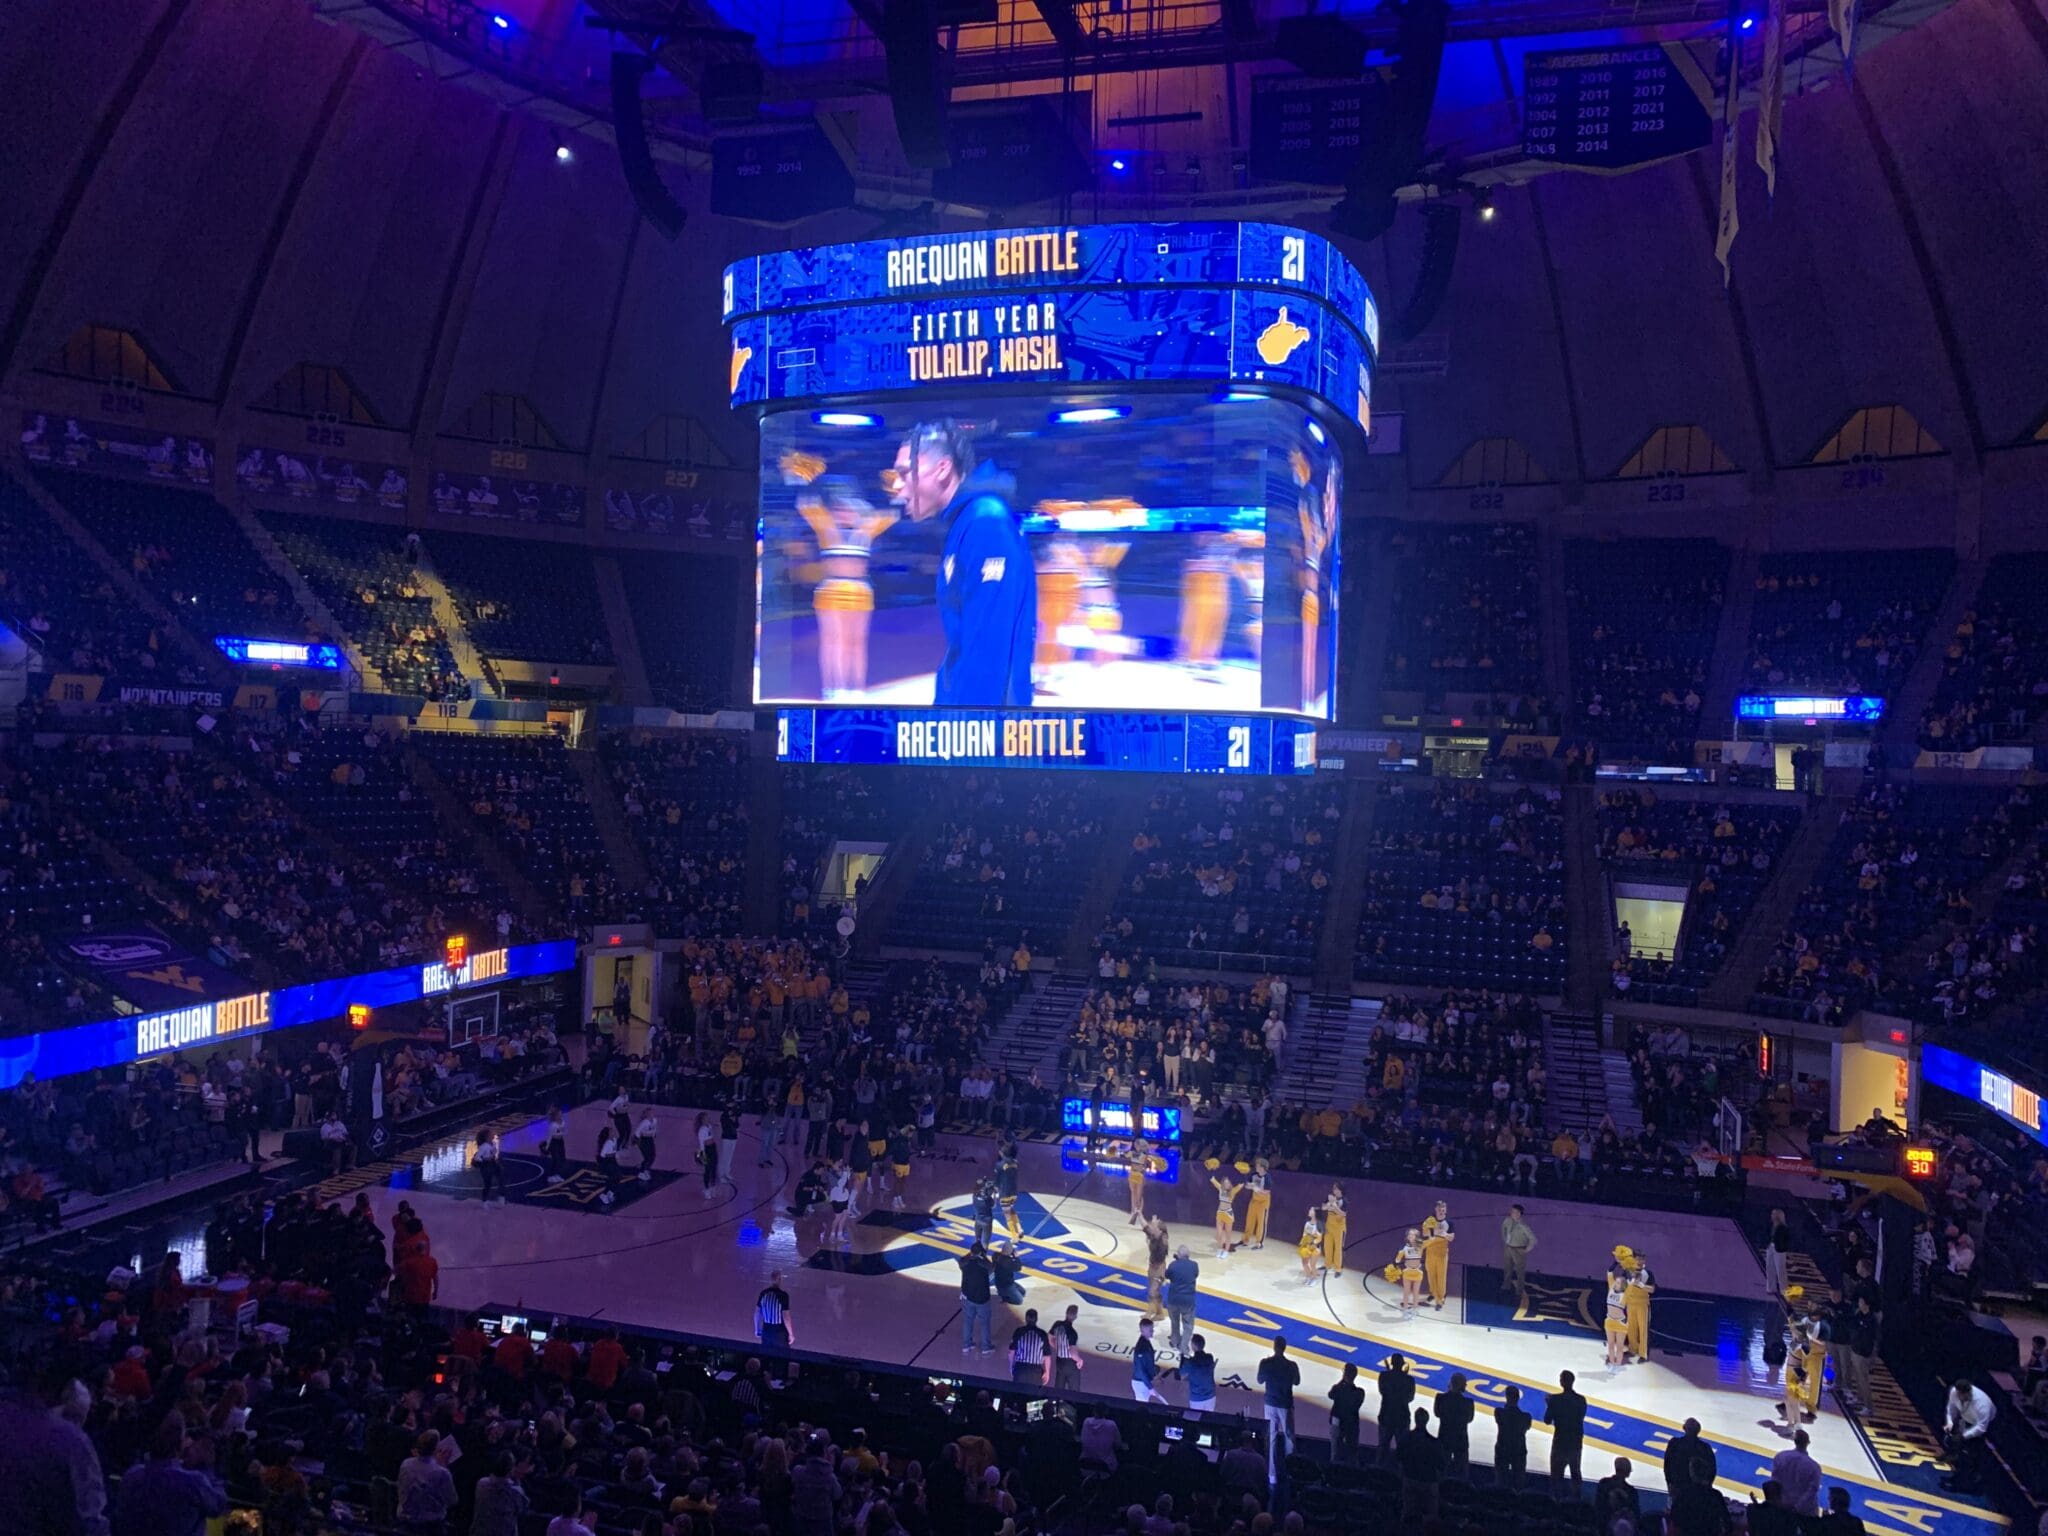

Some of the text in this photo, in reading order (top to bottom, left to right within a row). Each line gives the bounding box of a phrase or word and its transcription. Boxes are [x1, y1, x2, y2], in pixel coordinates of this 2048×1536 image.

[1634, 66, 1666, 80] 2016
[1579, 88, 1610, 102] 2011
[1633, 84, 1665, 97] 2017
[1577, 106, 1609, 119] 2012
[1632, 101, 1665, 115] 2021
[1576, 123, 1609, 136] 2013
[1631, 118, 1665, 132] 2023
[1575, 140, 1609, 153] 2014
[887, 239, 988, 289] RAEQUAN
[995, 230, 1079, 277] BATTLE
[1282, 235, 1305, 282] 21
[913, 302, 1055, 342] FIFTH YEAR
[907, 340, 994, 379] TULALIP,
[1000, 334, 1063, 373] WASH.
[664, 469, 699, 488] 227
[1647, 483, 1686, 502] 233
[119, 685, 224, 708] MOUNTAINEERS
[896, 718, 1087, 761] RAEQUAN BATTLE
[1228, 726, 1250, 767] 21
[472, 948, 508, 981] BATTLE
[137, 991, 270, 1056] RAEQUAN BATTLE
[1906, 1150, 1934, 1162] 20:00
[1911, 1161, 1929, 1174] 30
